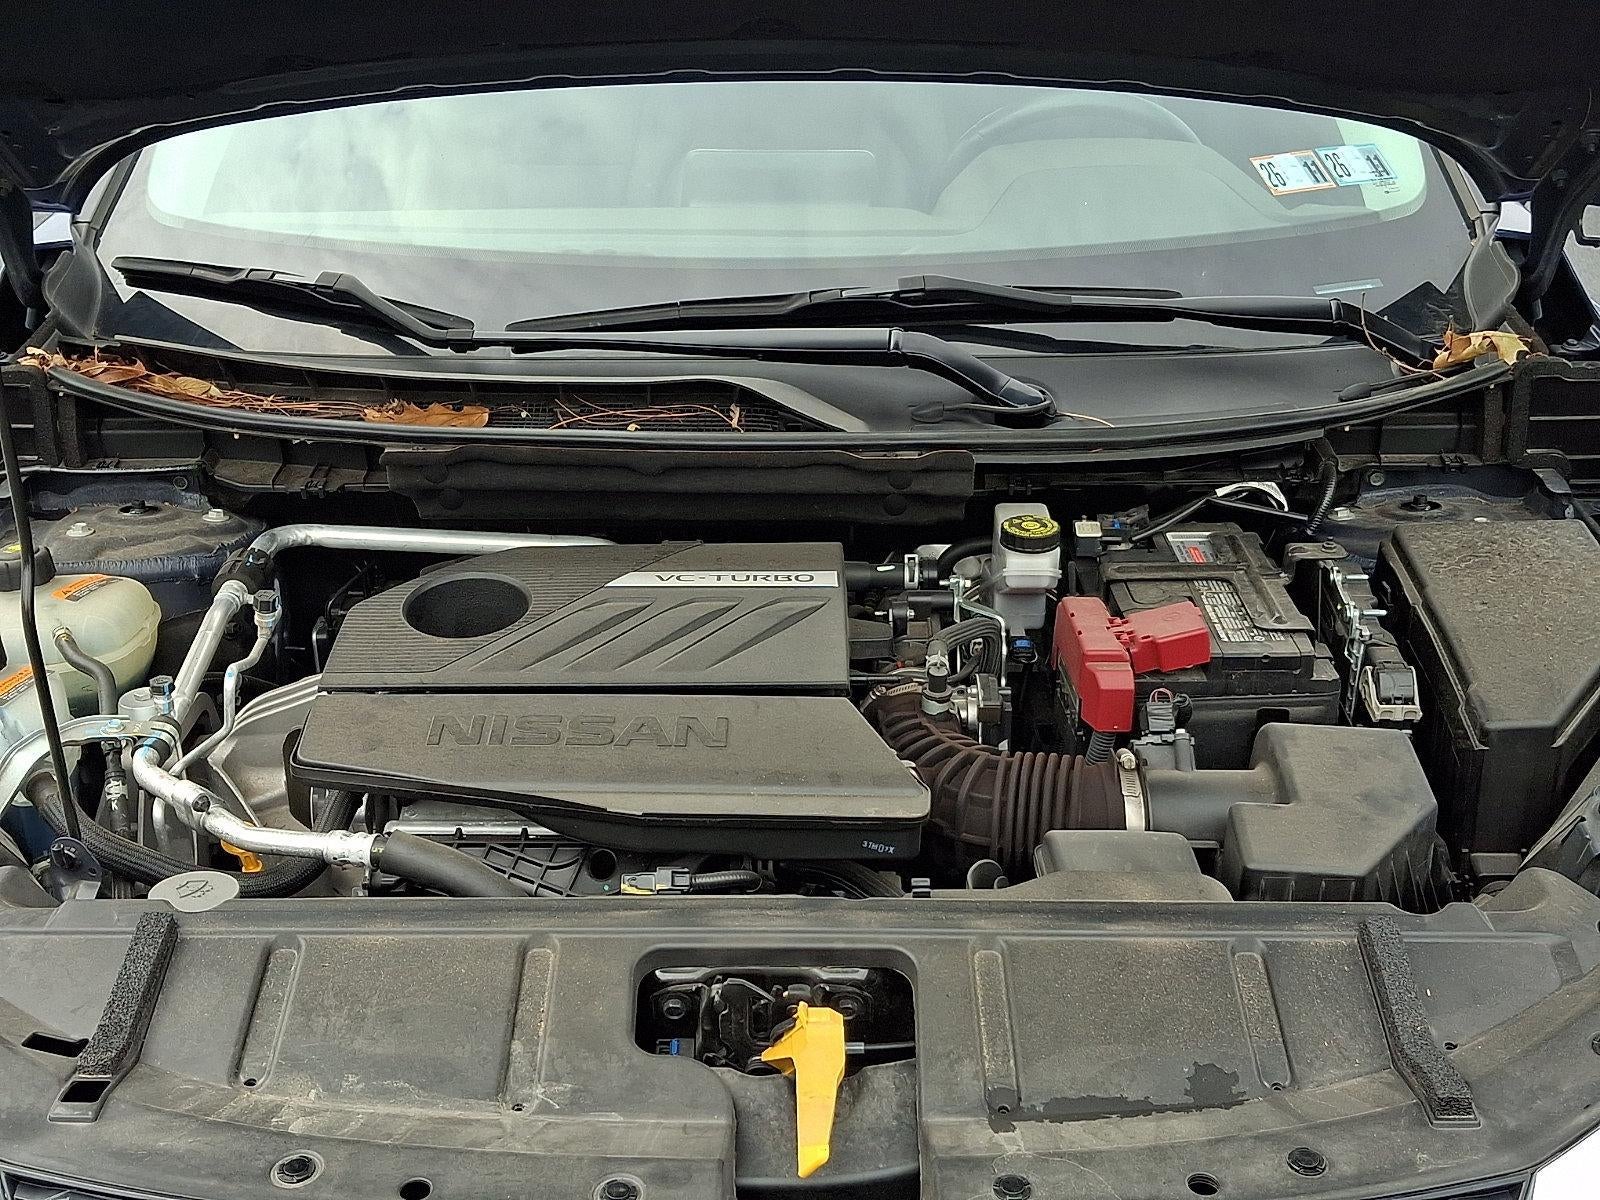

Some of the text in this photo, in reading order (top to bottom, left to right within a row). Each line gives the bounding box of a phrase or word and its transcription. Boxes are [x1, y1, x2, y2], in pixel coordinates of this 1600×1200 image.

[1259, 160, 1328, 187] 26 11
[1325, 153, 1351, 177] 26
[655, 574, 815, 582] VC-TURBO
[426, 714, 729, 748] NISSAN
